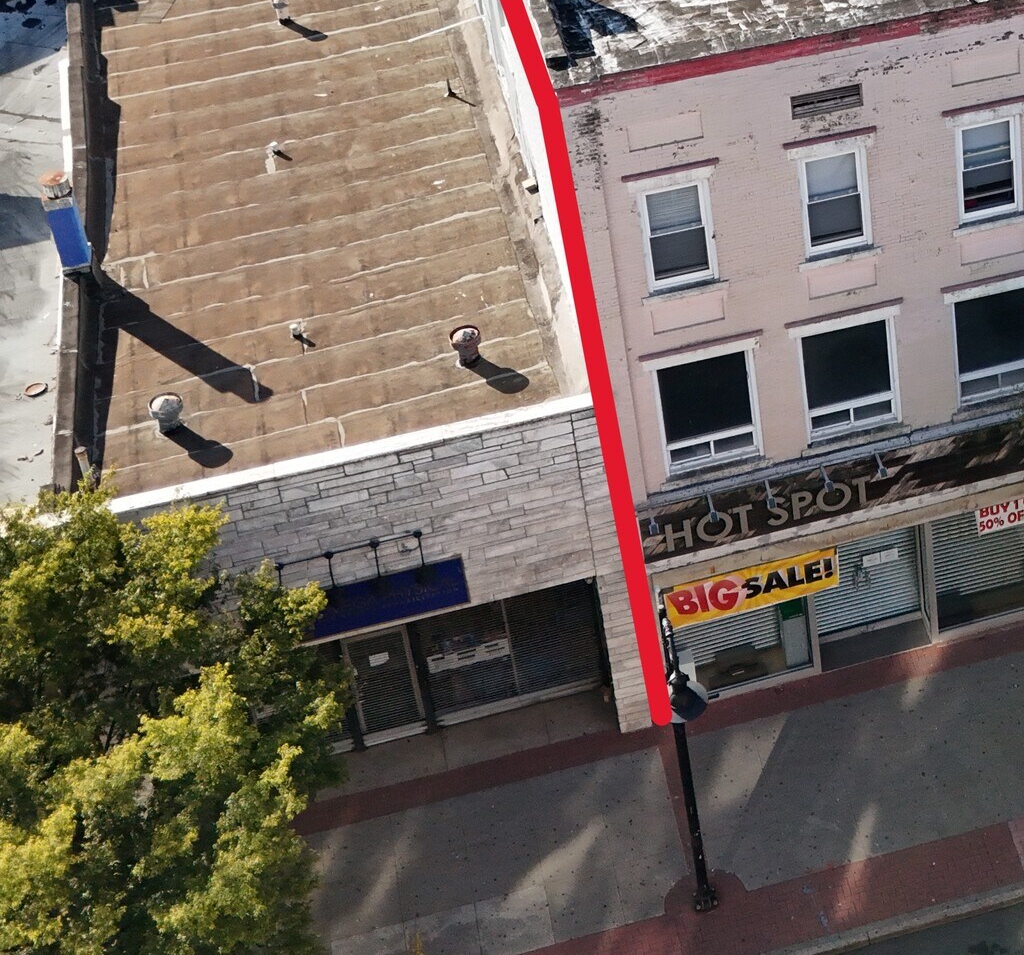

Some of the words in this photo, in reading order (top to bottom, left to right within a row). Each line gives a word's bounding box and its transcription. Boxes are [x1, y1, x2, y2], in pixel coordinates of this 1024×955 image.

[664, 504, 753, 553] HOT
[767, 475, 873, 527] SPOT
[979, 501, 1010, 518] BUY
[979, 517, 1005, 532] 50%
[666, 578, 740, 616] BIG
[740, 557, 834, 599] SALE!
